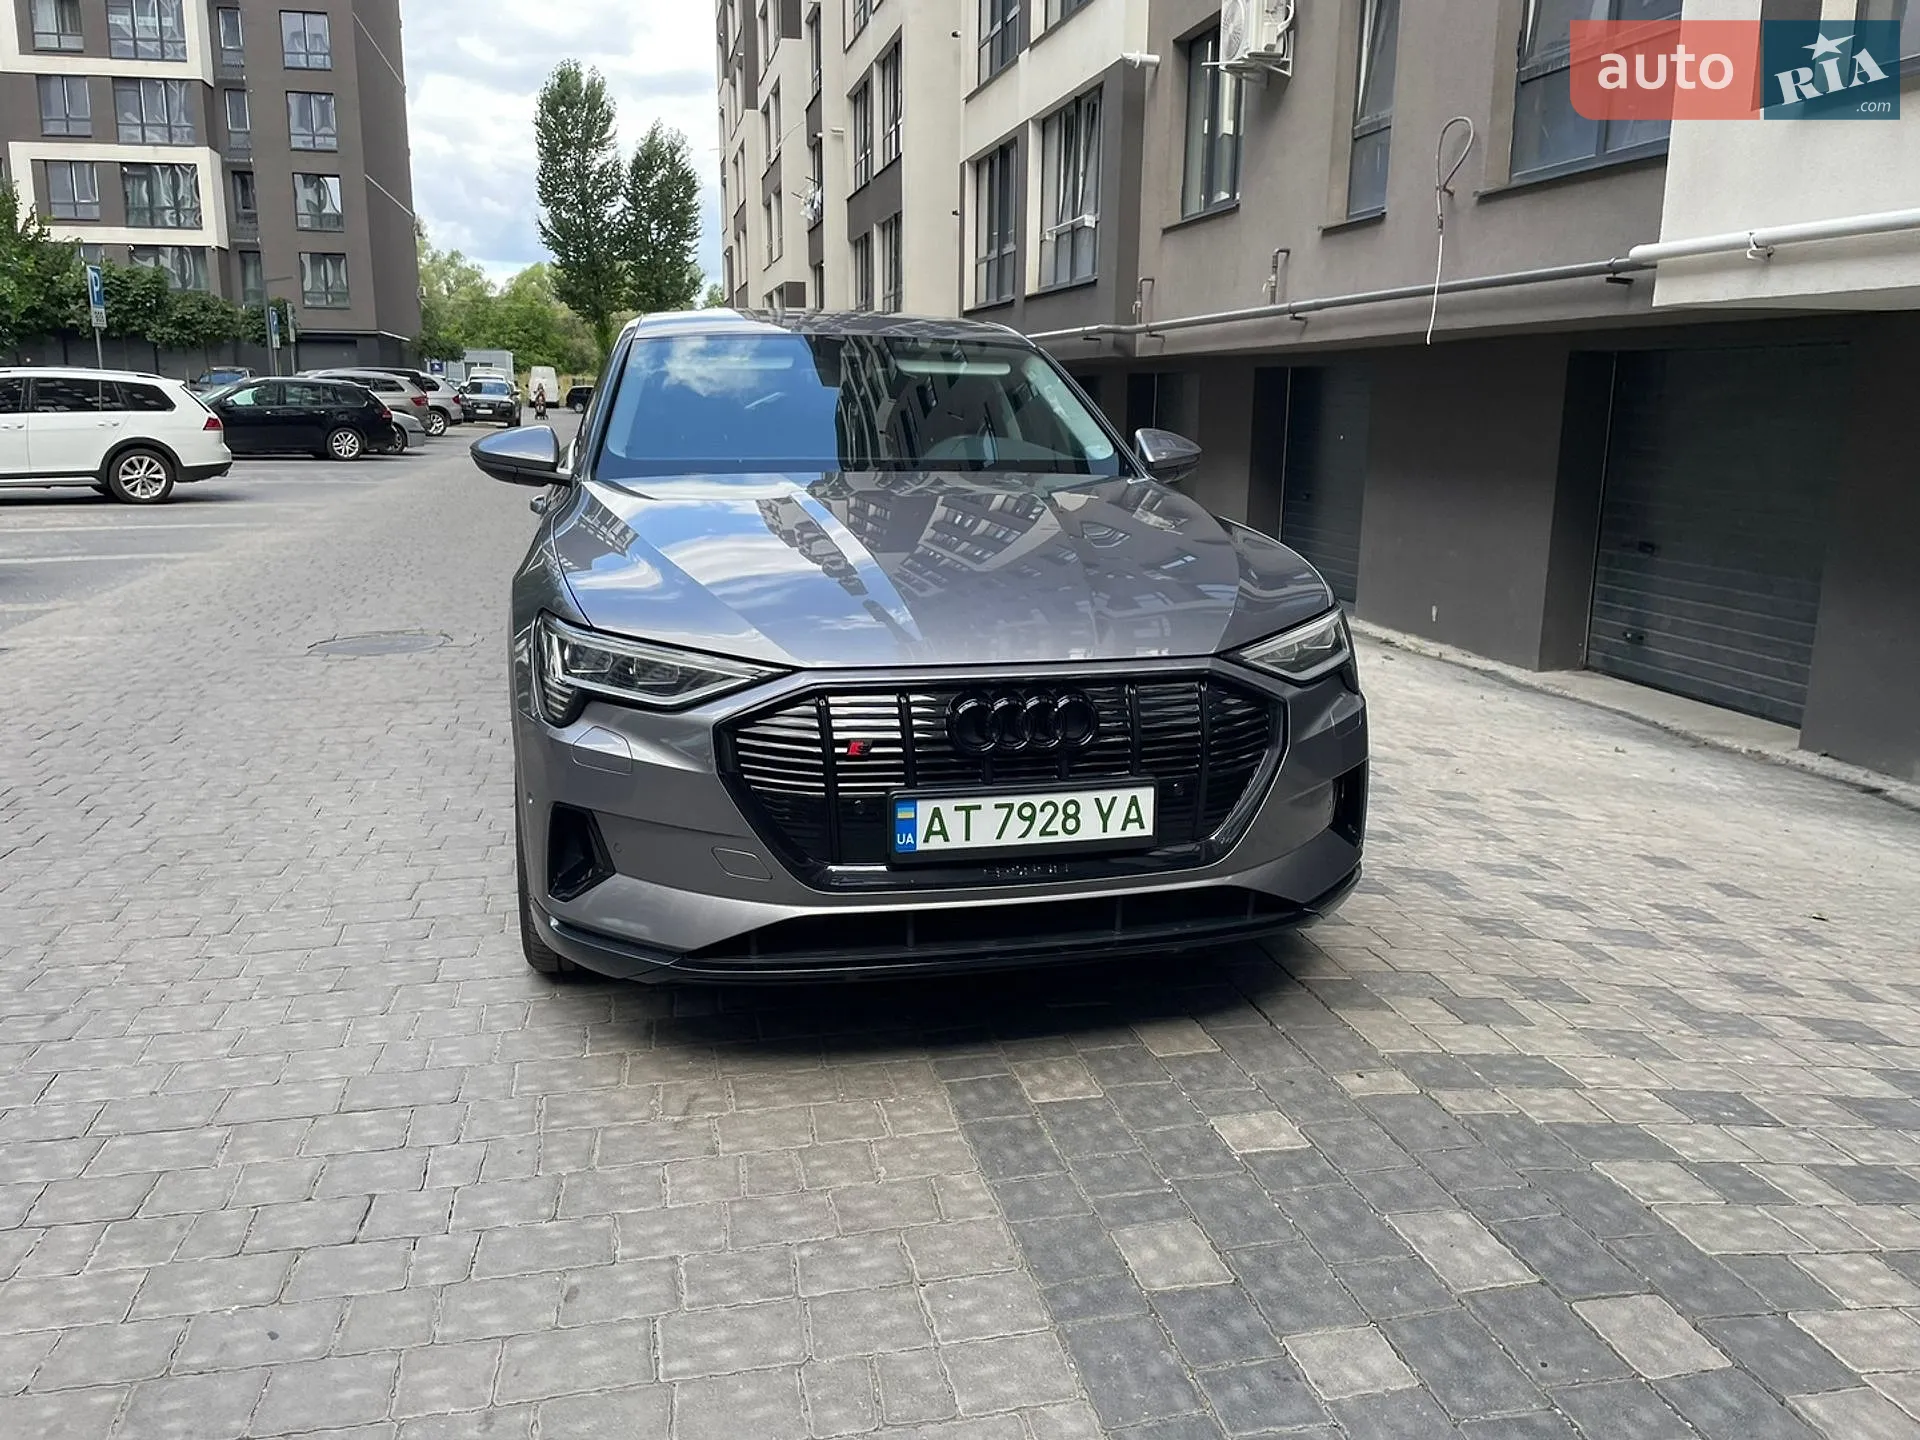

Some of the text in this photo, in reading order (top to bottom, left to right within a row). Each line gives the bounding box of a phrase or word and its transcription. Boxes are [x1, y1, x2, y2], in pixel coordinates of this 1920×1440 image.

[91, 272, 100, 302] P
[922, 794, 1146, 843] AT 7928 YA
[897, 833, 915, 846] UA
